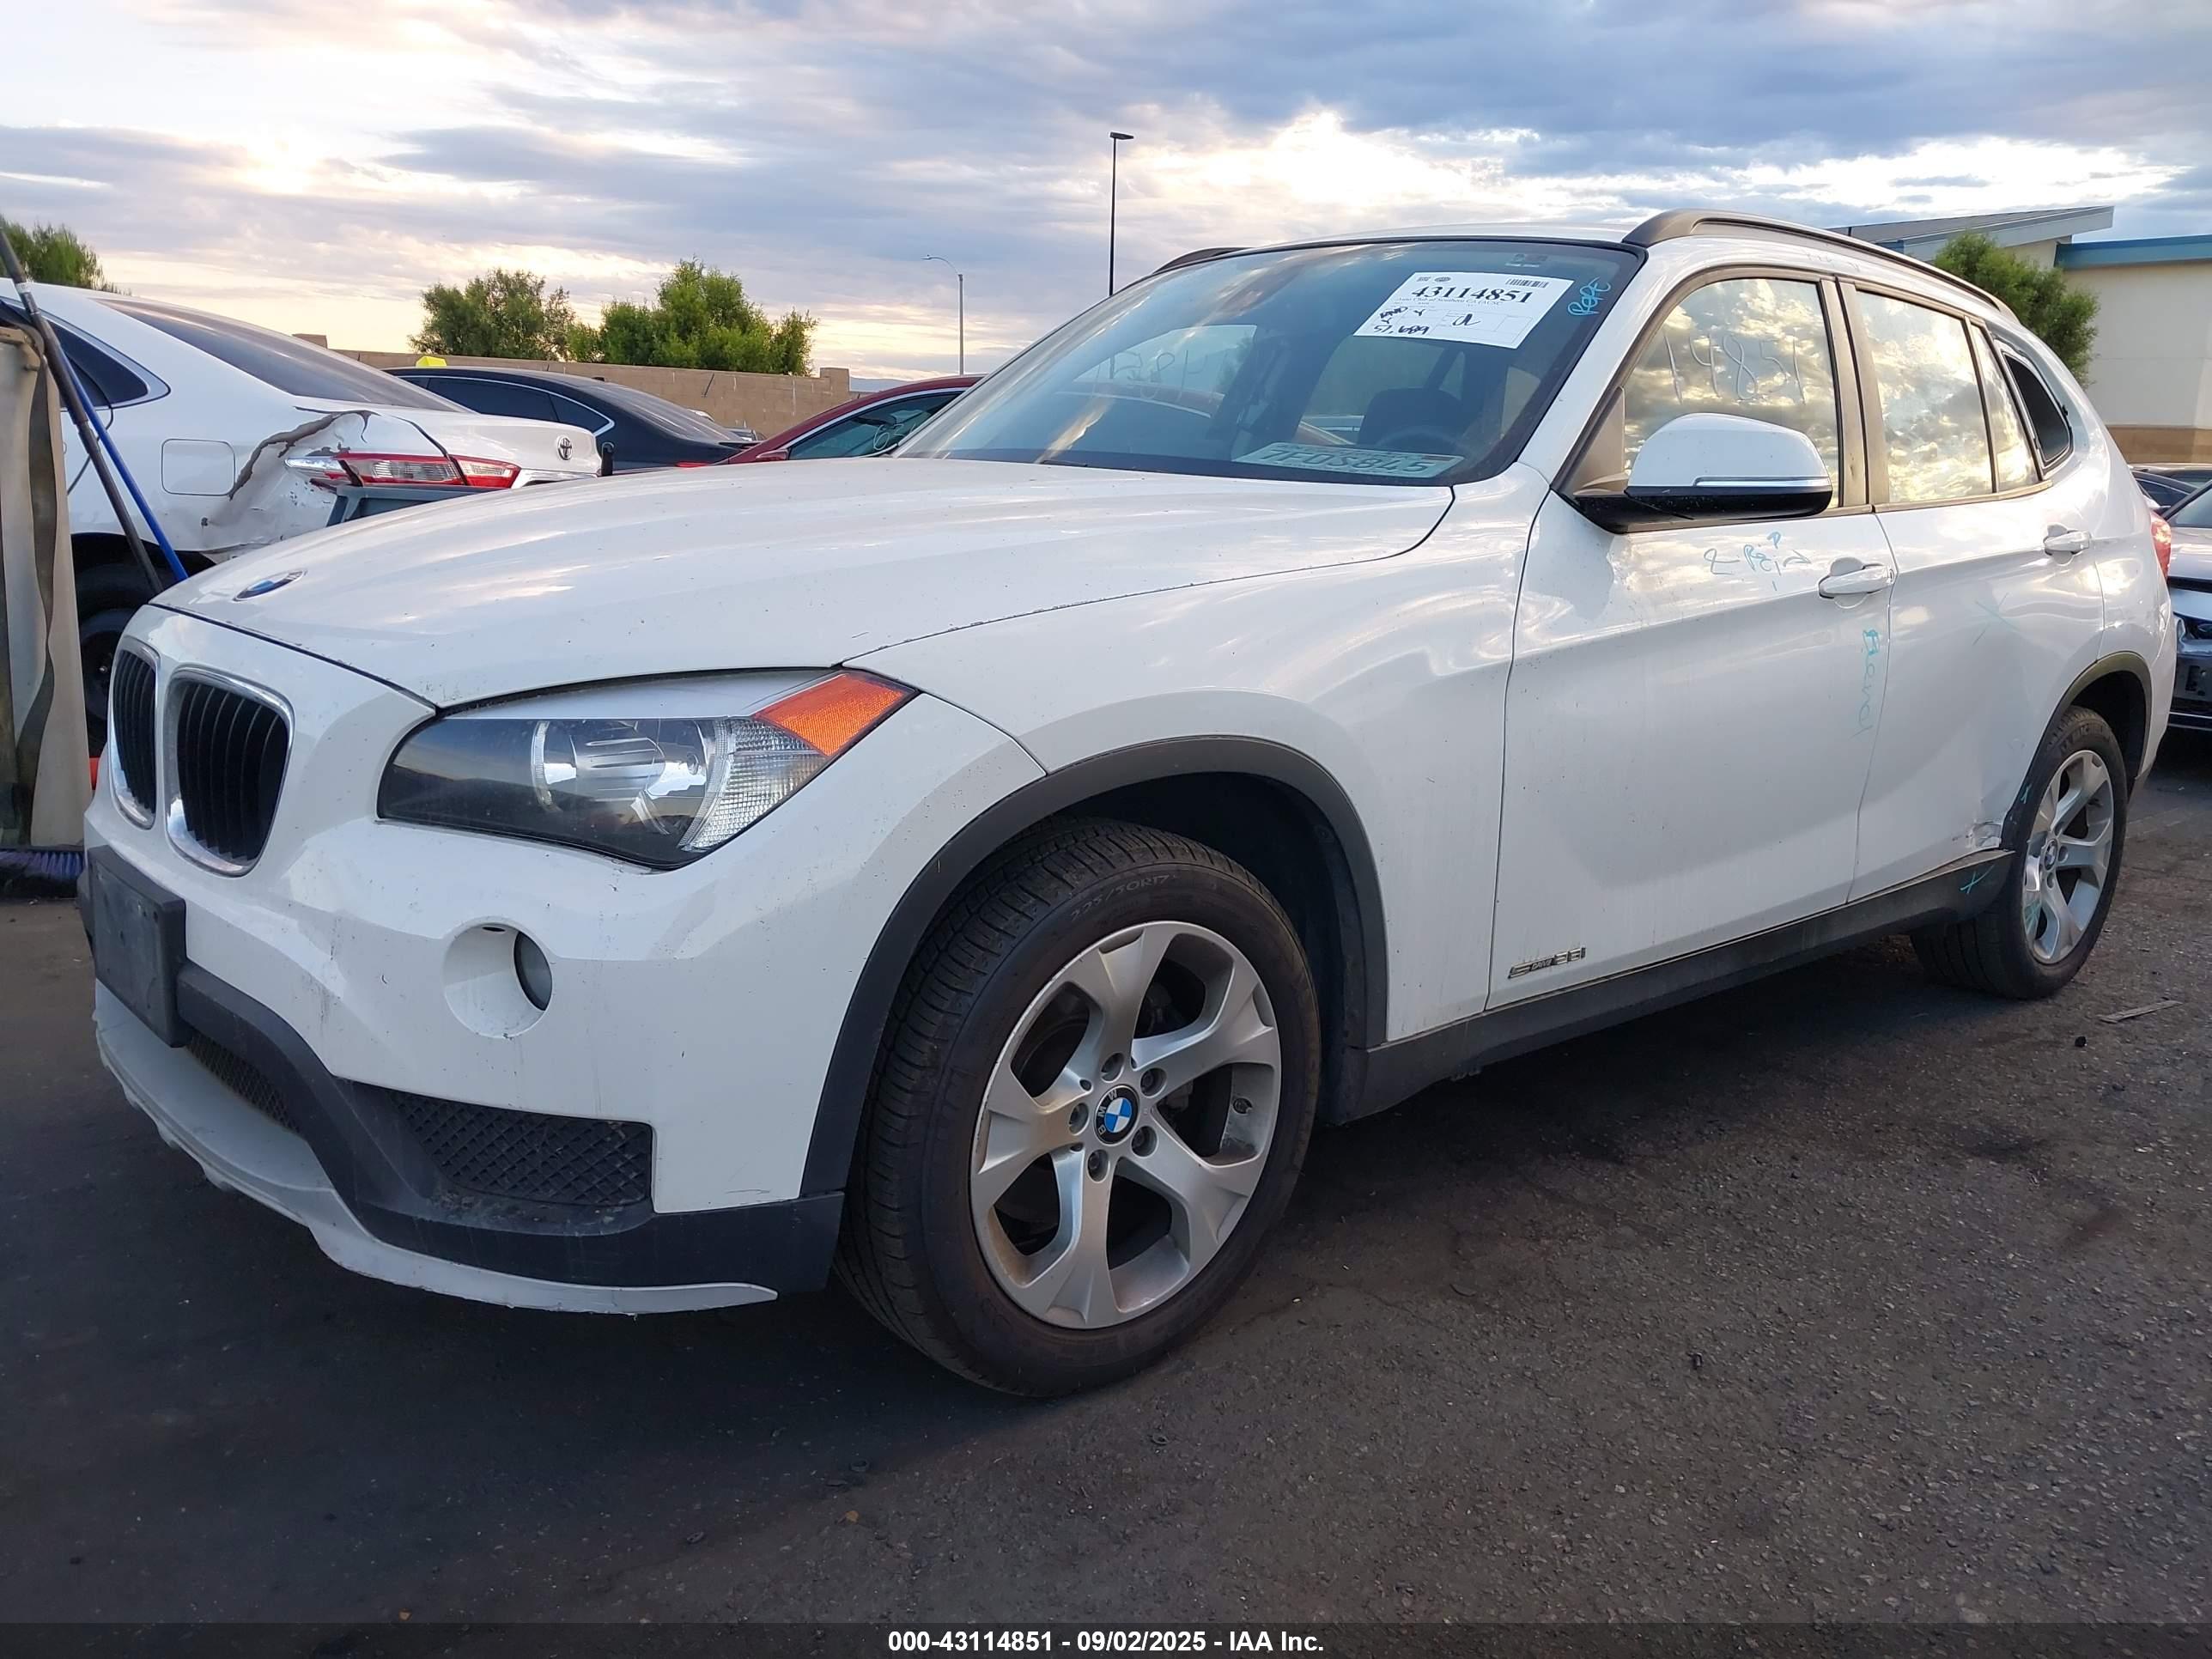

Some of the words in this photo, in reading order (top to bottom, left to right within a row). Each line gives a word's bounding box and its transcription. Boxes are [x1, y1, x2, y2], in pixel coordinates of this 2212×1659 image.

[1412, 285, 1533, 303] 43114851
[1663, 333, 1806, 405] 14851
[1097, 1088, 1118, 1135] BMW
